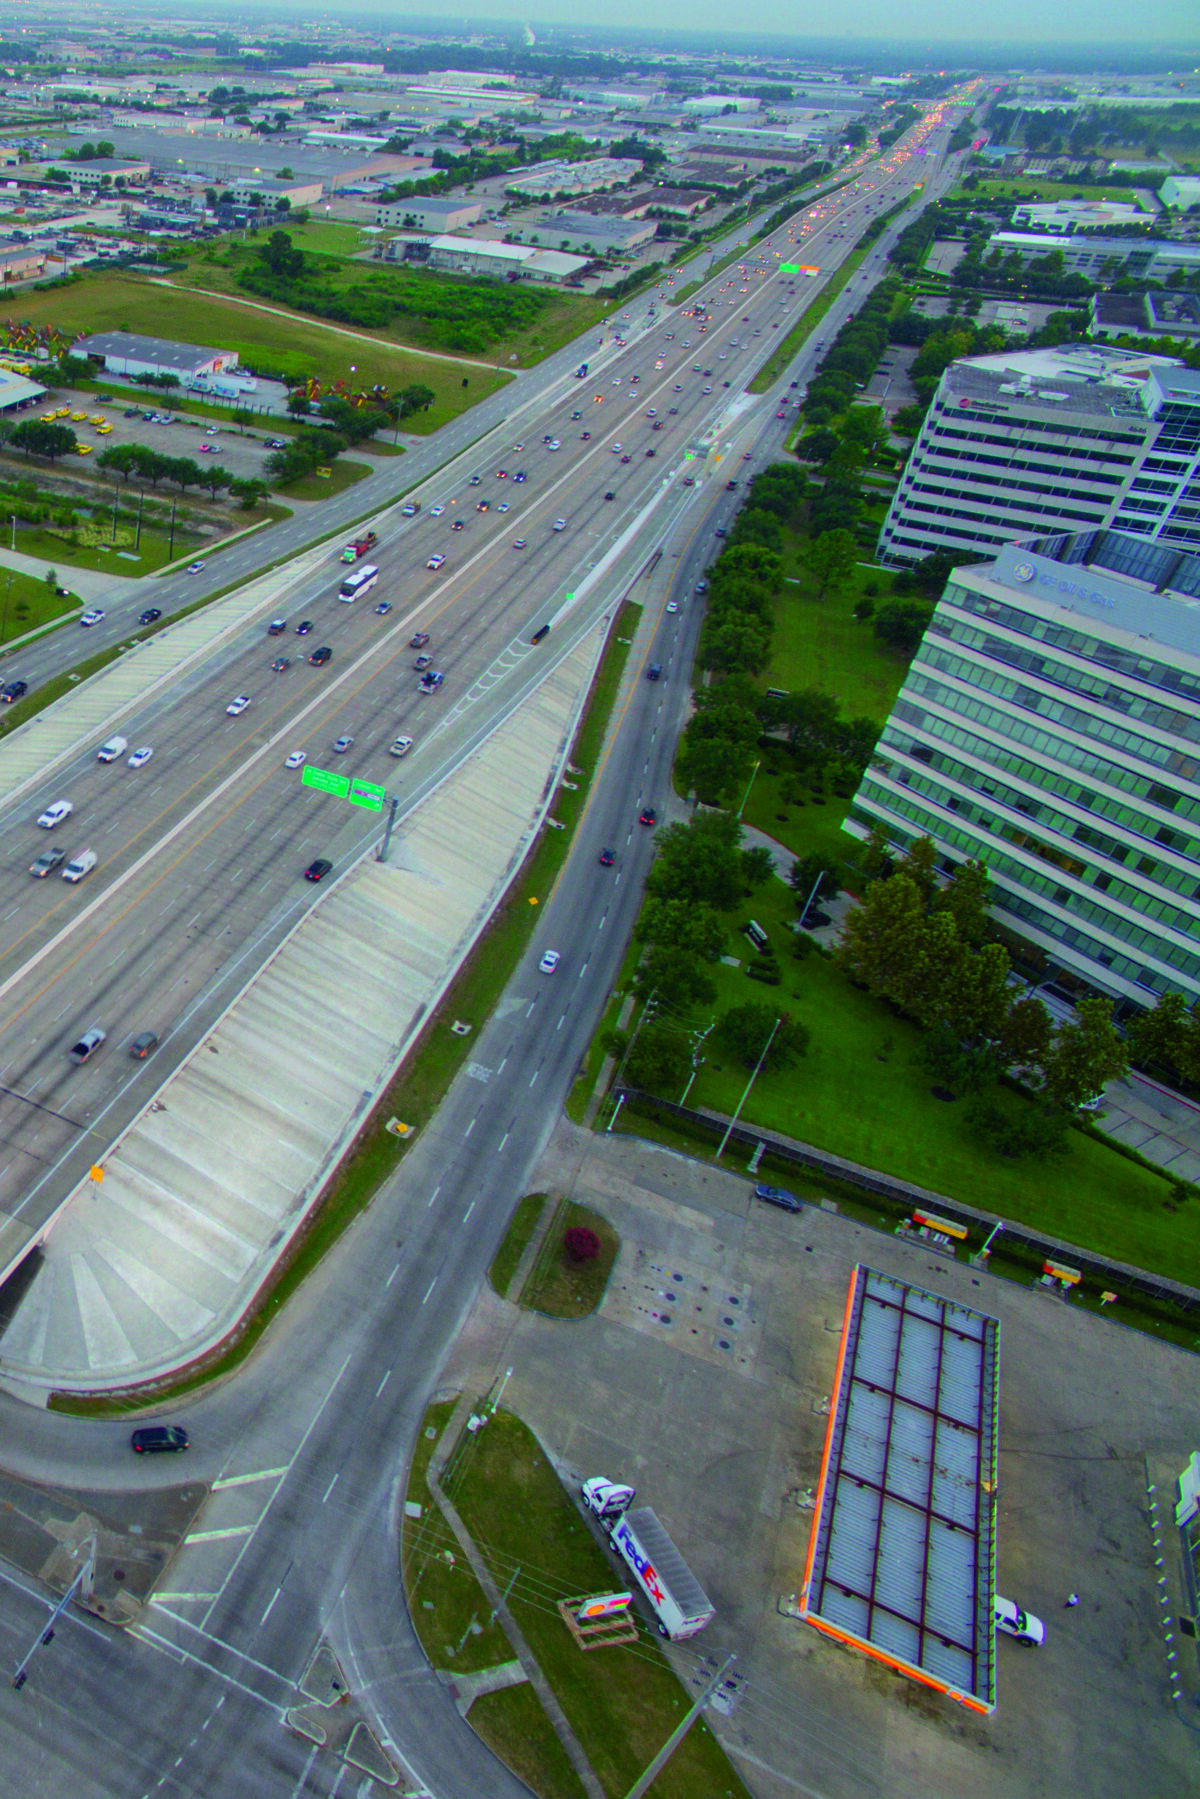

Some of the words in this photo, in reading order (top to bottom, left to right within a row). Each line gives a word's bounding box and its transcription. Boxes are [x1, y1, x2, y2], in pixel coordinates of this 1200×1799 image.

[1058, 581, 1077, 594] Oil
[1090, 592, 1115, 608] Gas
[617, 1523, 666, 1607] FedEx
